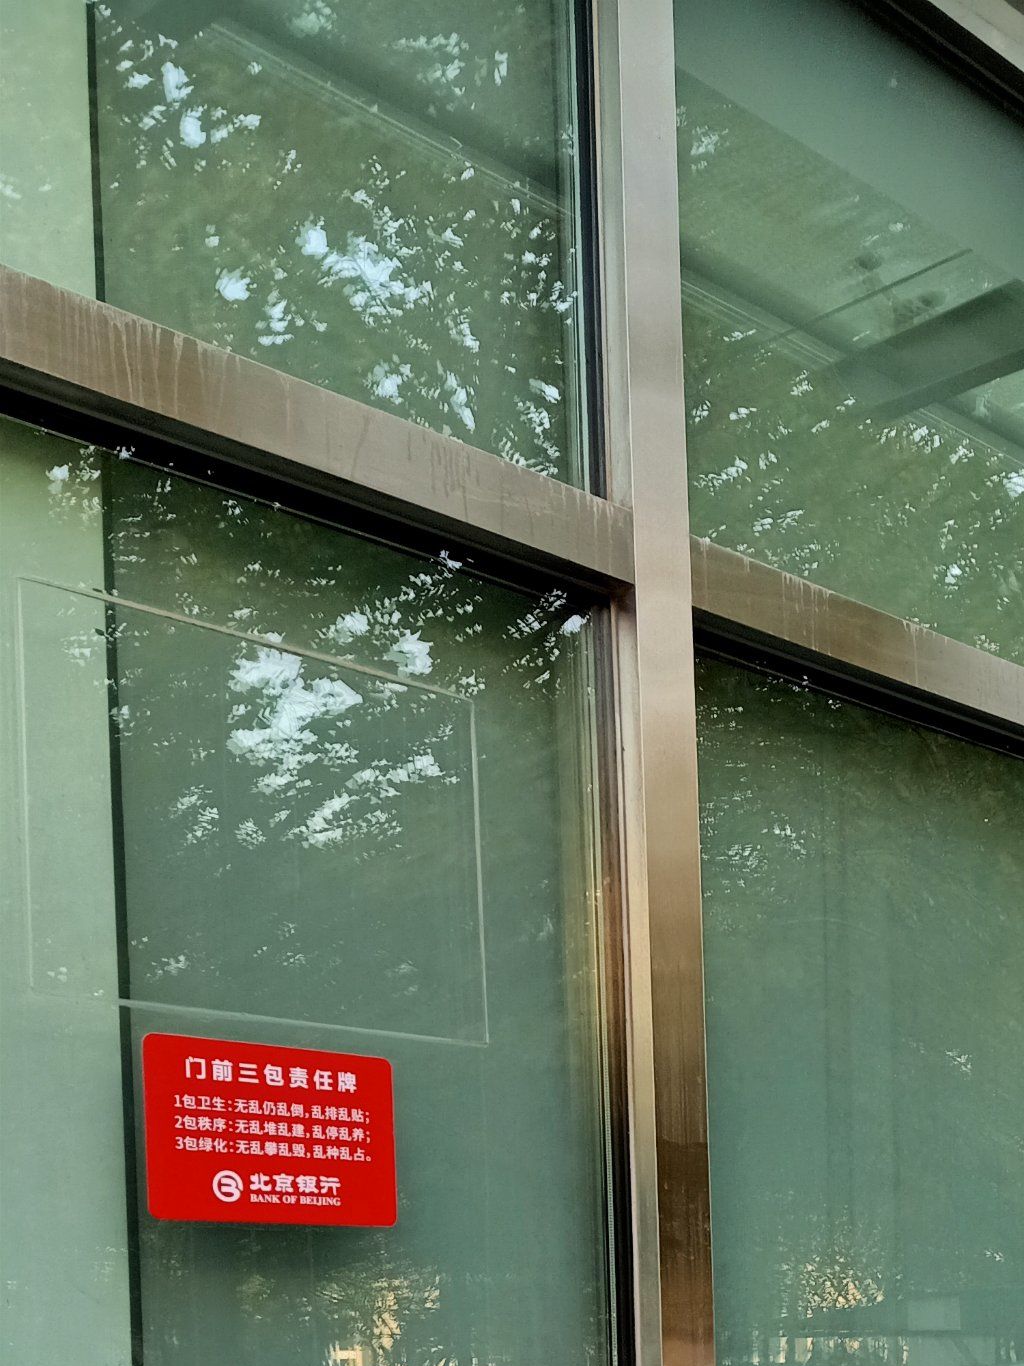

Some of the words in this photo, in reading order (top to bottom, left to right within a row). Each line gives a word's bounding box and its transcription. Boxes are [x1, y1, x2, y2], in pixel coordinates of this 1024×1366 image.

[185, 1056, 357, 1093] 门前三包责任牌
[250, 1173, 341, 1195] 北京银行
[250, 1194, 280, 1204] BANK
[283, 1195, 297, 1204] OF
[300, 1196, 341, 1206] BEIJING
